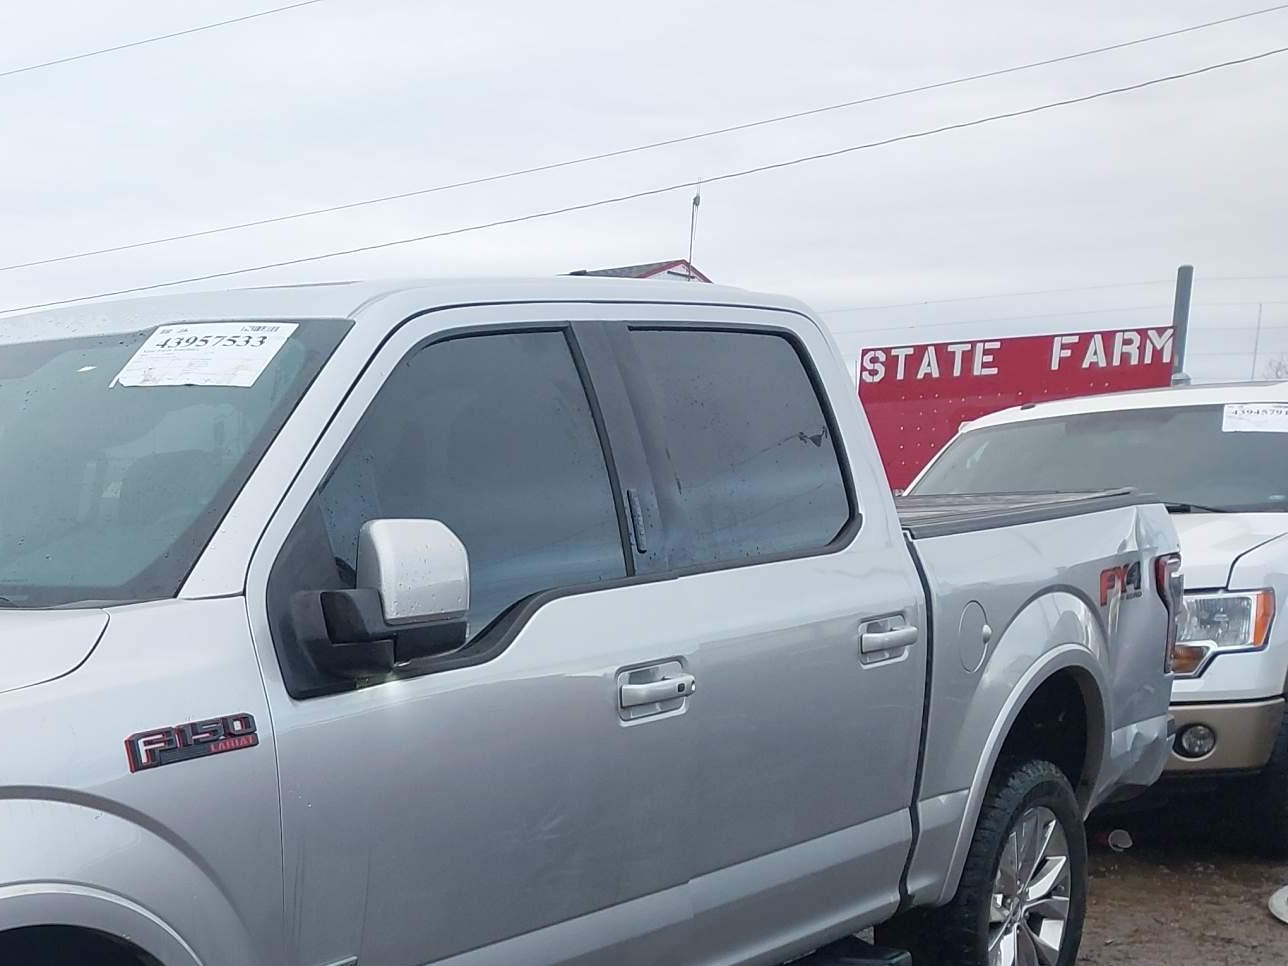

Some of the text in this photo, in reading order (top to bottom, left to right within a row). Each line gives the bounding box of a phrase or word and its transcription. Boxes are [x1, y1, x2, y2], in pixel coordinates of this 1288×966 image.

[156, 335, 268, 348] 43957533
[861, 328, 1175, 383] STATE FARM
[209, 735, 254, 753] LARIAT
